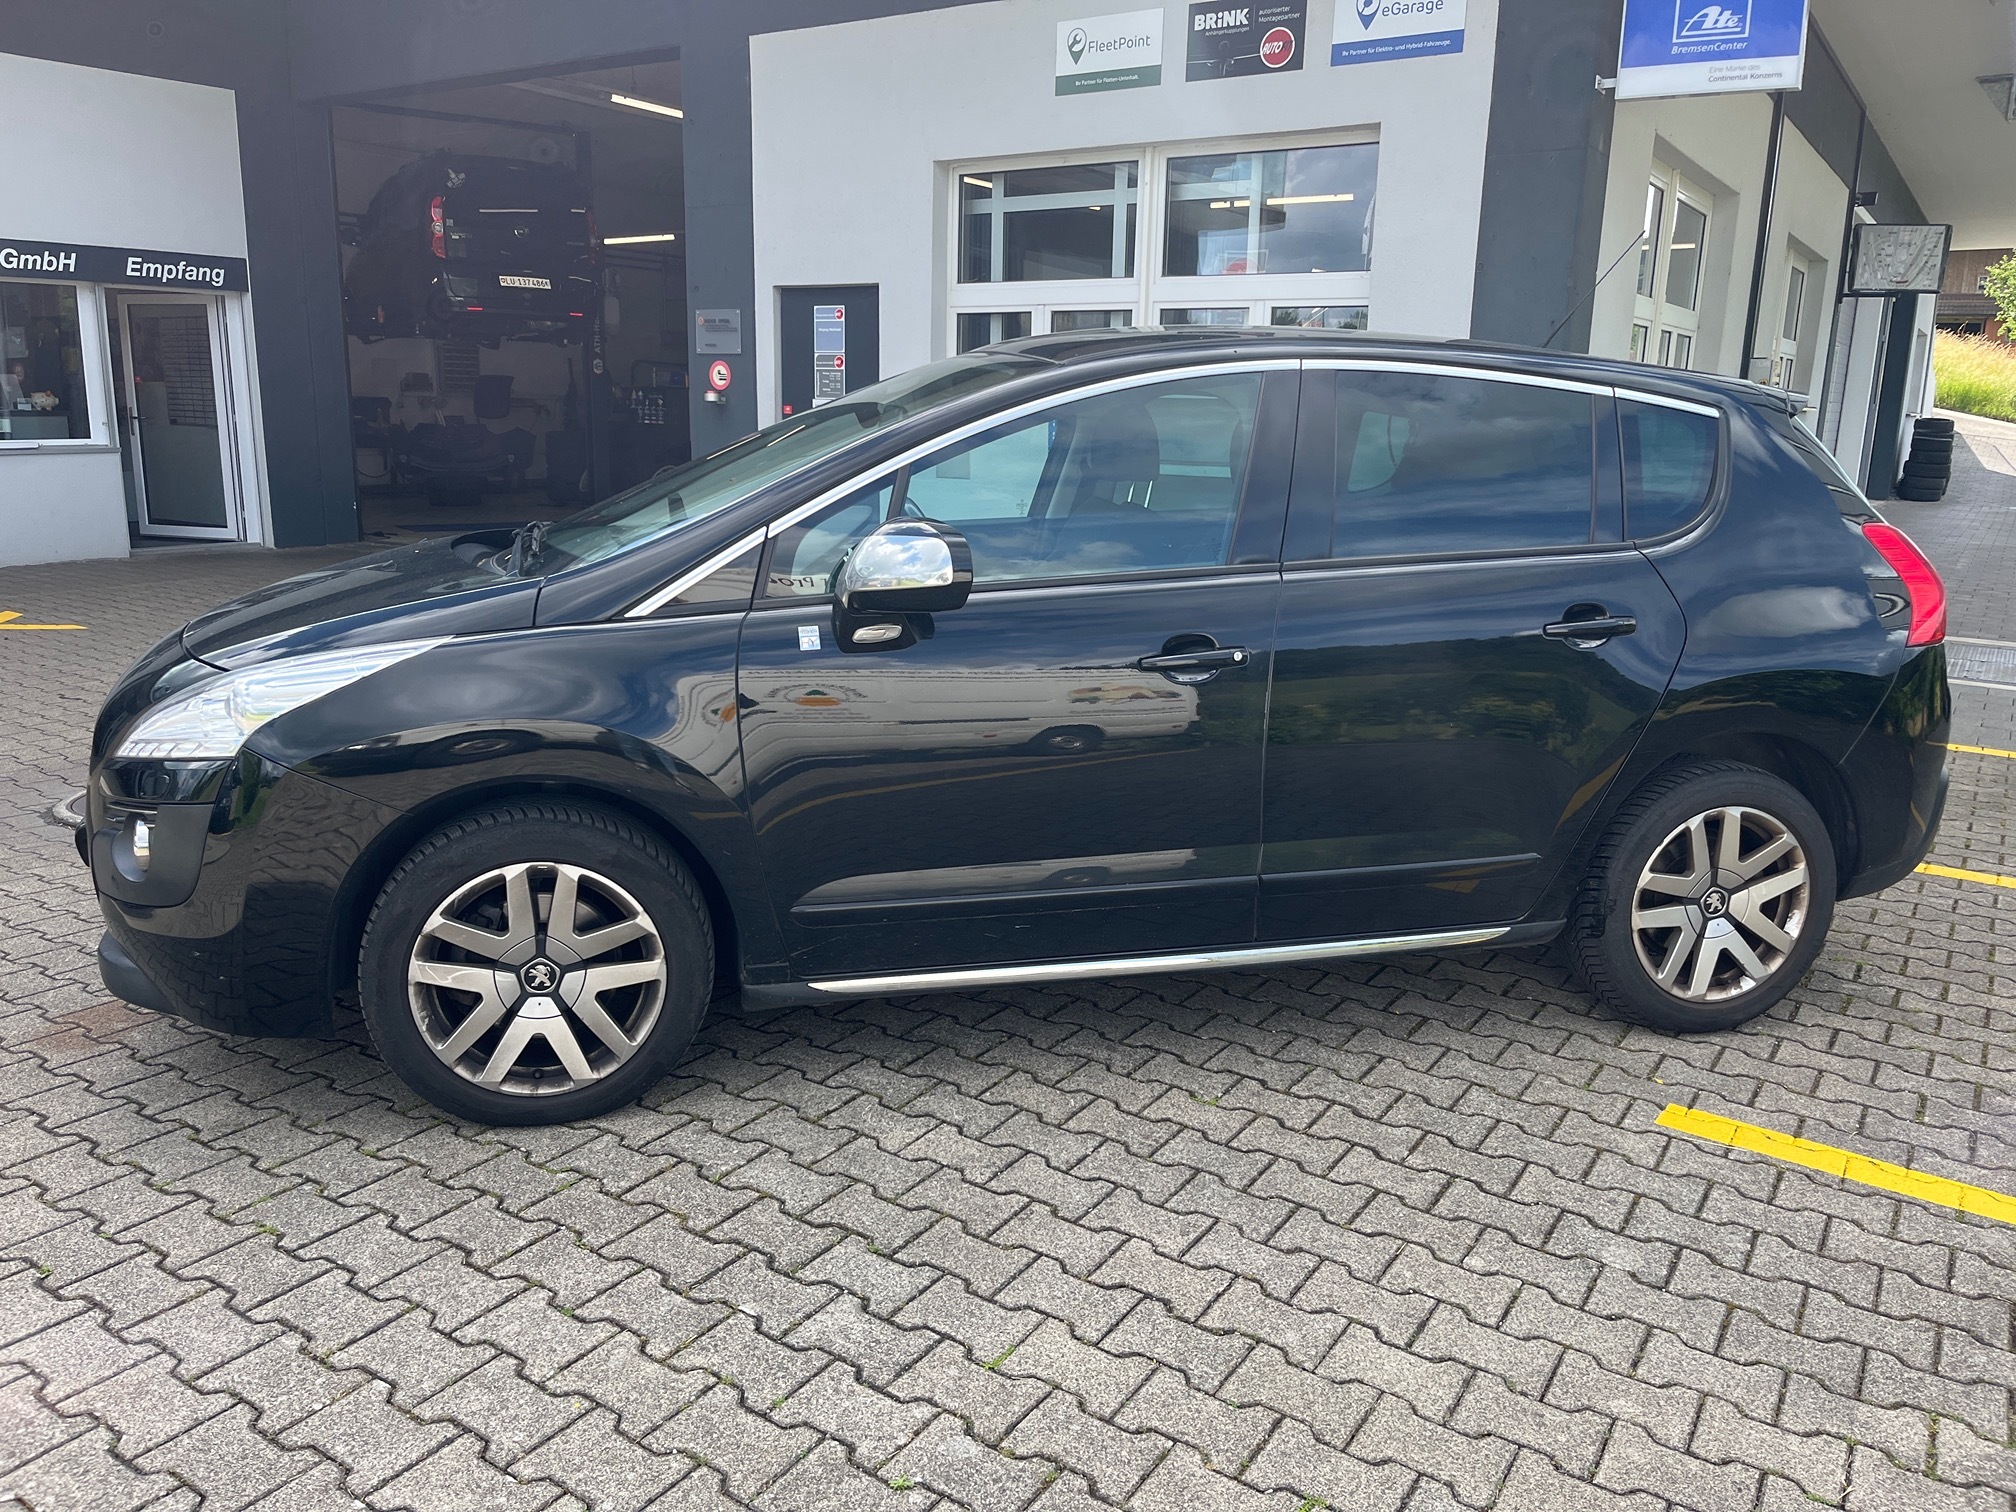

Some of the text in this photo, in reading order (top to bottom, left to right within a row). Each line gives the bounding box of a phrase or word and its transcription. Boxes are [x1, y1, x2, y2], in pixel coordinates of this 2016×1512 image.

[1258, 6, 1291, 16] autorisierter
[1381, 0, 1444, 17] eGarage
[1258, 12, 1301, 23] Montagepartner
[1680, 5, 1744, 36] Ate
[1205, 26, 1250, 37] Anhängerkupplungen
[1087, 35, 1151, 54] FleetPoint
[1350, 48, 1368, 56] Partner
[1376, 45, 1395, 53] Elektro-
[1406, 39, 1452, 50] Hybrid-Fahrzeuge.
[1671, 41, 1748, 55] BremsenCenter
[1709, 66, 1724, 74] Eine
[1726, 65, 1747, 73] Marke
[1708, 71, 1783, 83] Continental Konzerns
[0, 247, 226, 287] GmbH Empfang
